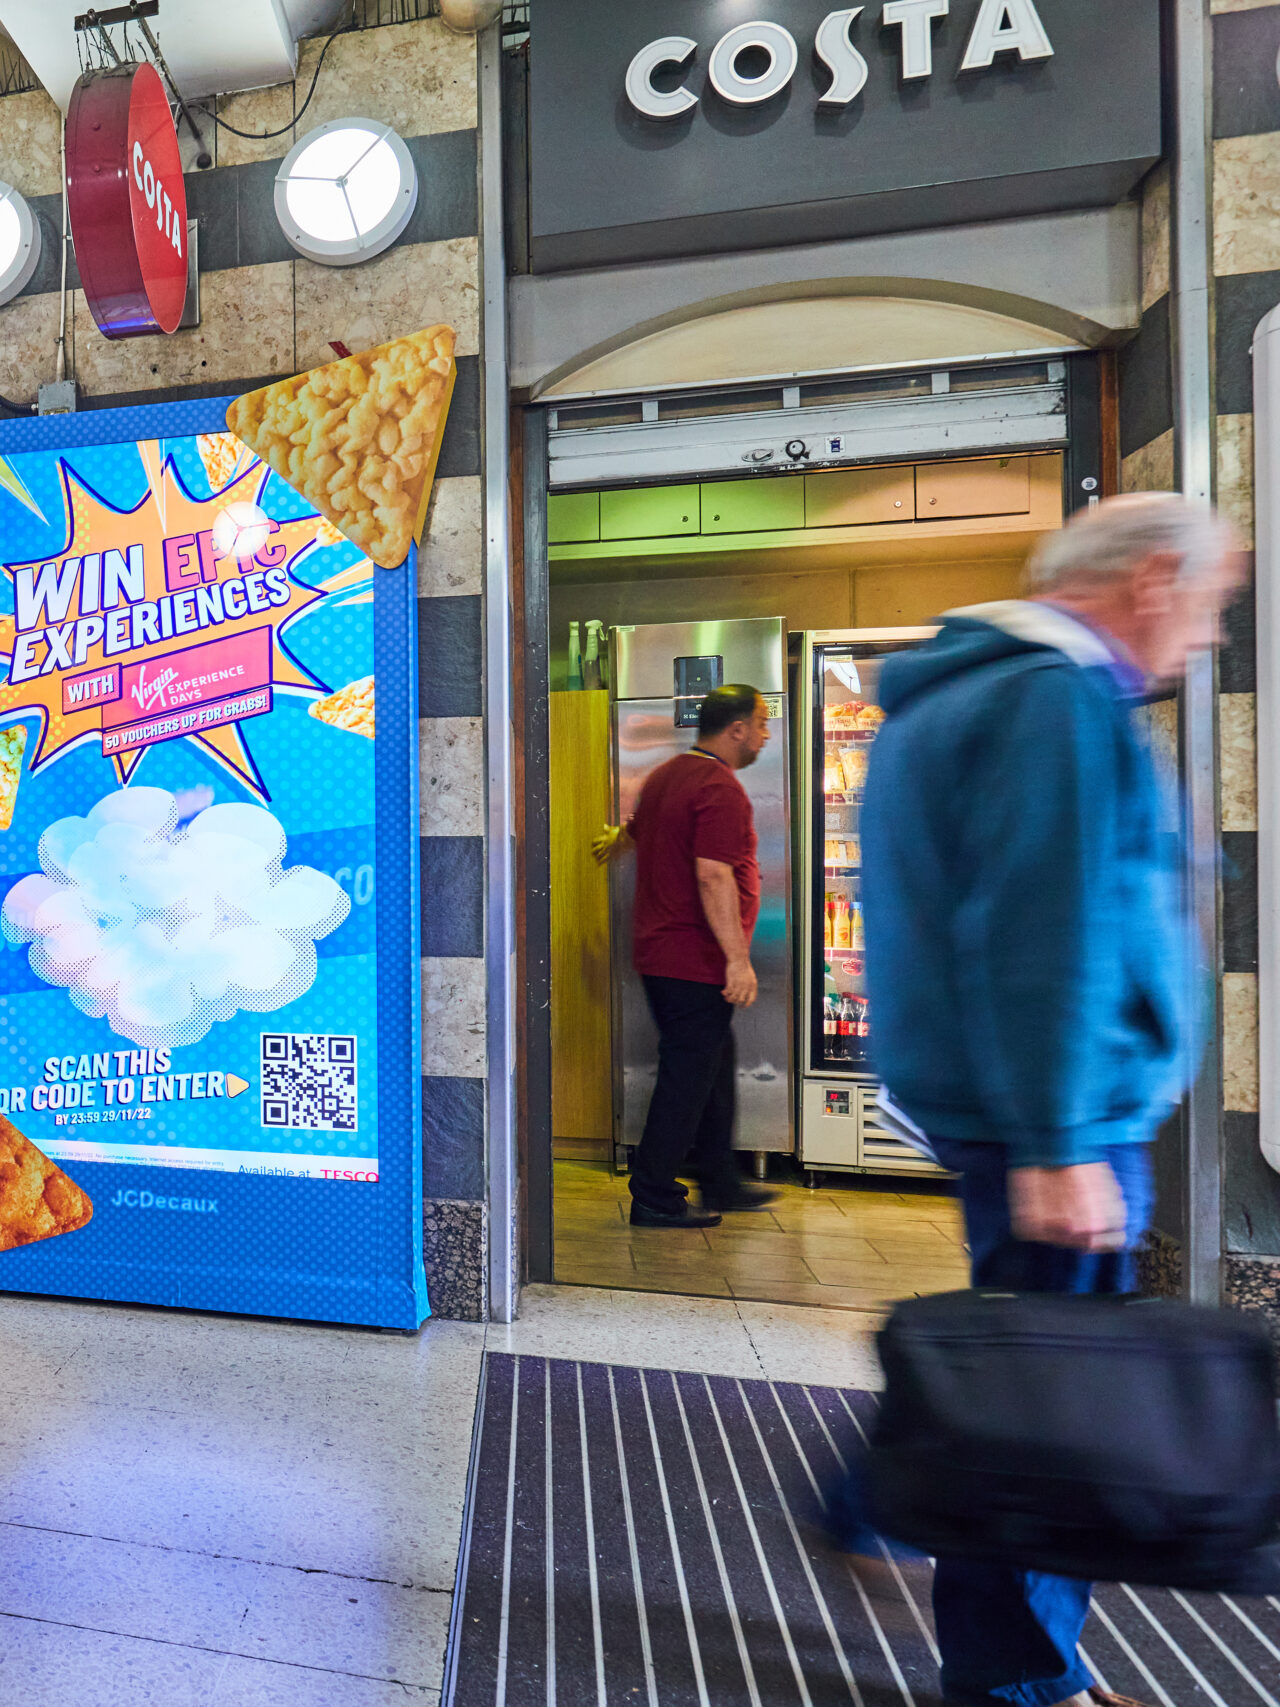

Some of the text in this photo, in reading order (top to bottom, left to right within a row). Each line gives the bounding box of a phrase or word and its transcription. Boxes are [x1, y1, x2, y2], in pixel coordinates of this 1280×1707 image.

[624, 0, 1056, 122] COSTA
[133, 141, 182, 258] COSTA
[14, 518, 287, 633] WIN EPIC
[8, 568, 292, 686] EXPERIENCES
[66, 673, 115, 705] WITH
[131, 665, 179, 710] Virgin
[167, 664, 245, 694] EXPERIENCE
[170, 689, 202, 705] DAYS
[105, 694, 268, 750] 50 VOUCHERS UP FOR GRABS!
[43, 1047, 173, 1082] SCAN THIS
[31, 1081, 96, 1111] CODE
[102, 1077, 136, 1105] TO
[140, 1071, 225, 1103] ENTER
[55, 1107, 152, 1126] BY 23:59 29/11/22
[238, 1164, 380, 1183] Available at TESCO
[111, 1189, 220, 1213] JCDecaux
